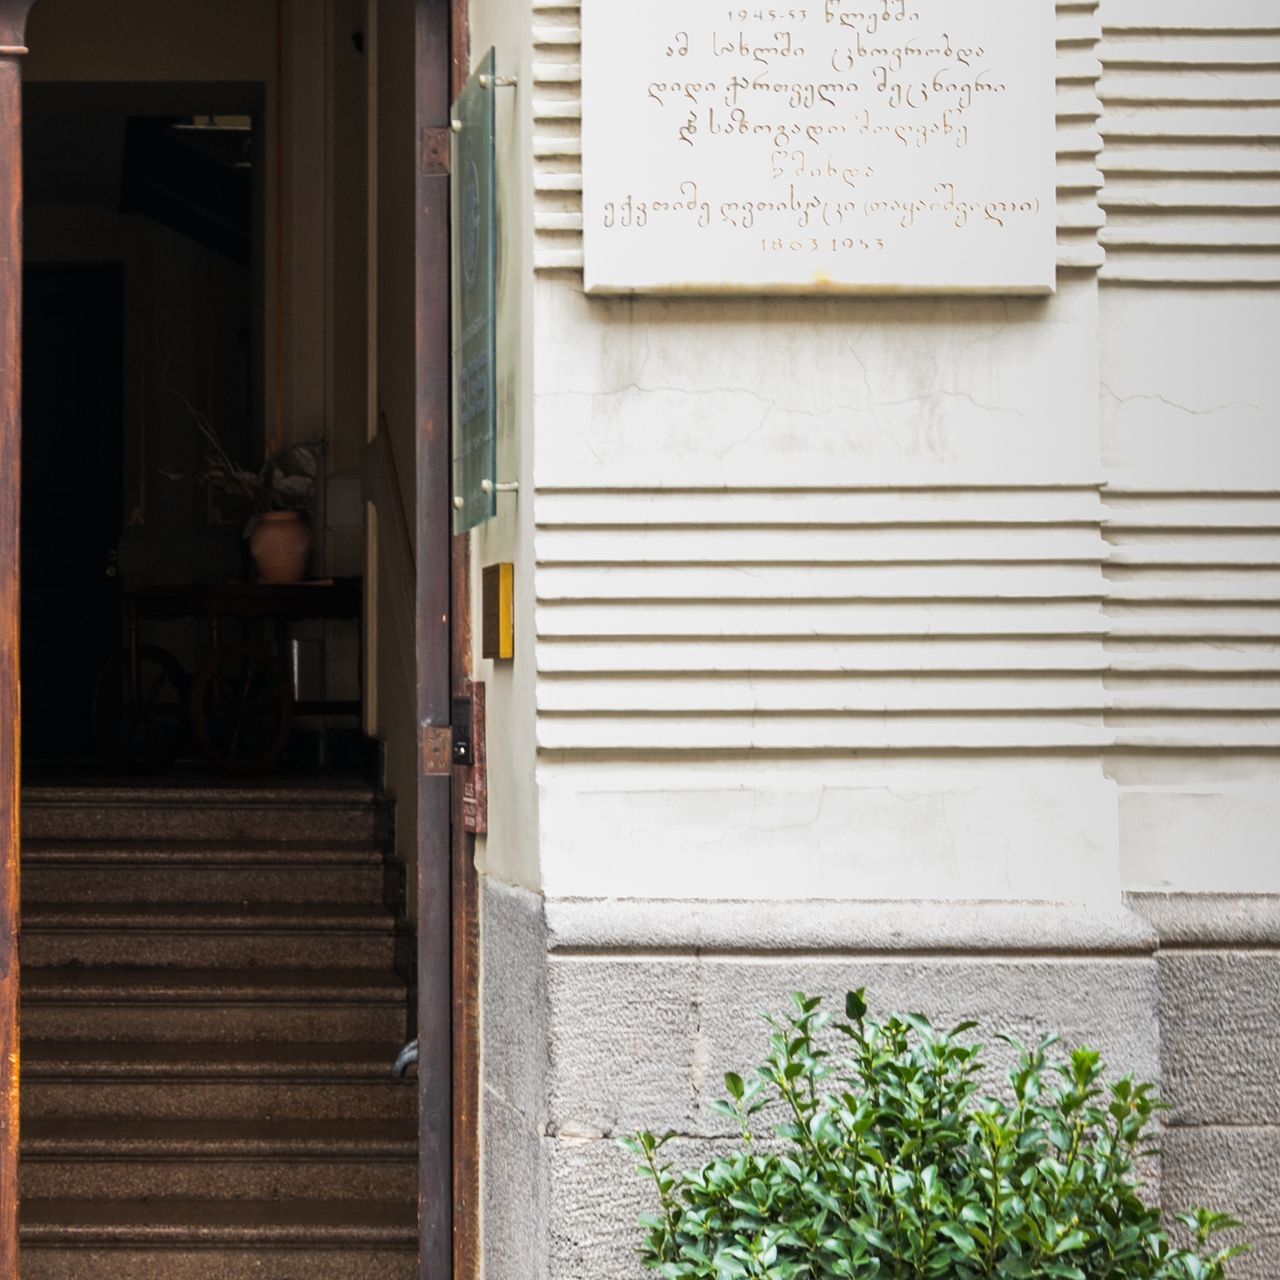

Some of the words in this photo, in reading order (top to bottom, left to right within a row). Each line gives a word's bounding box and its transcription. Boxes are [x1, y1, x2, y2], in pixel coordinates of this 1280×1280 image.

[665, 32, 689, 57] ამ
[713, 31, 806, 66] სახლში
[648, 80, 716, 106] დიდი
